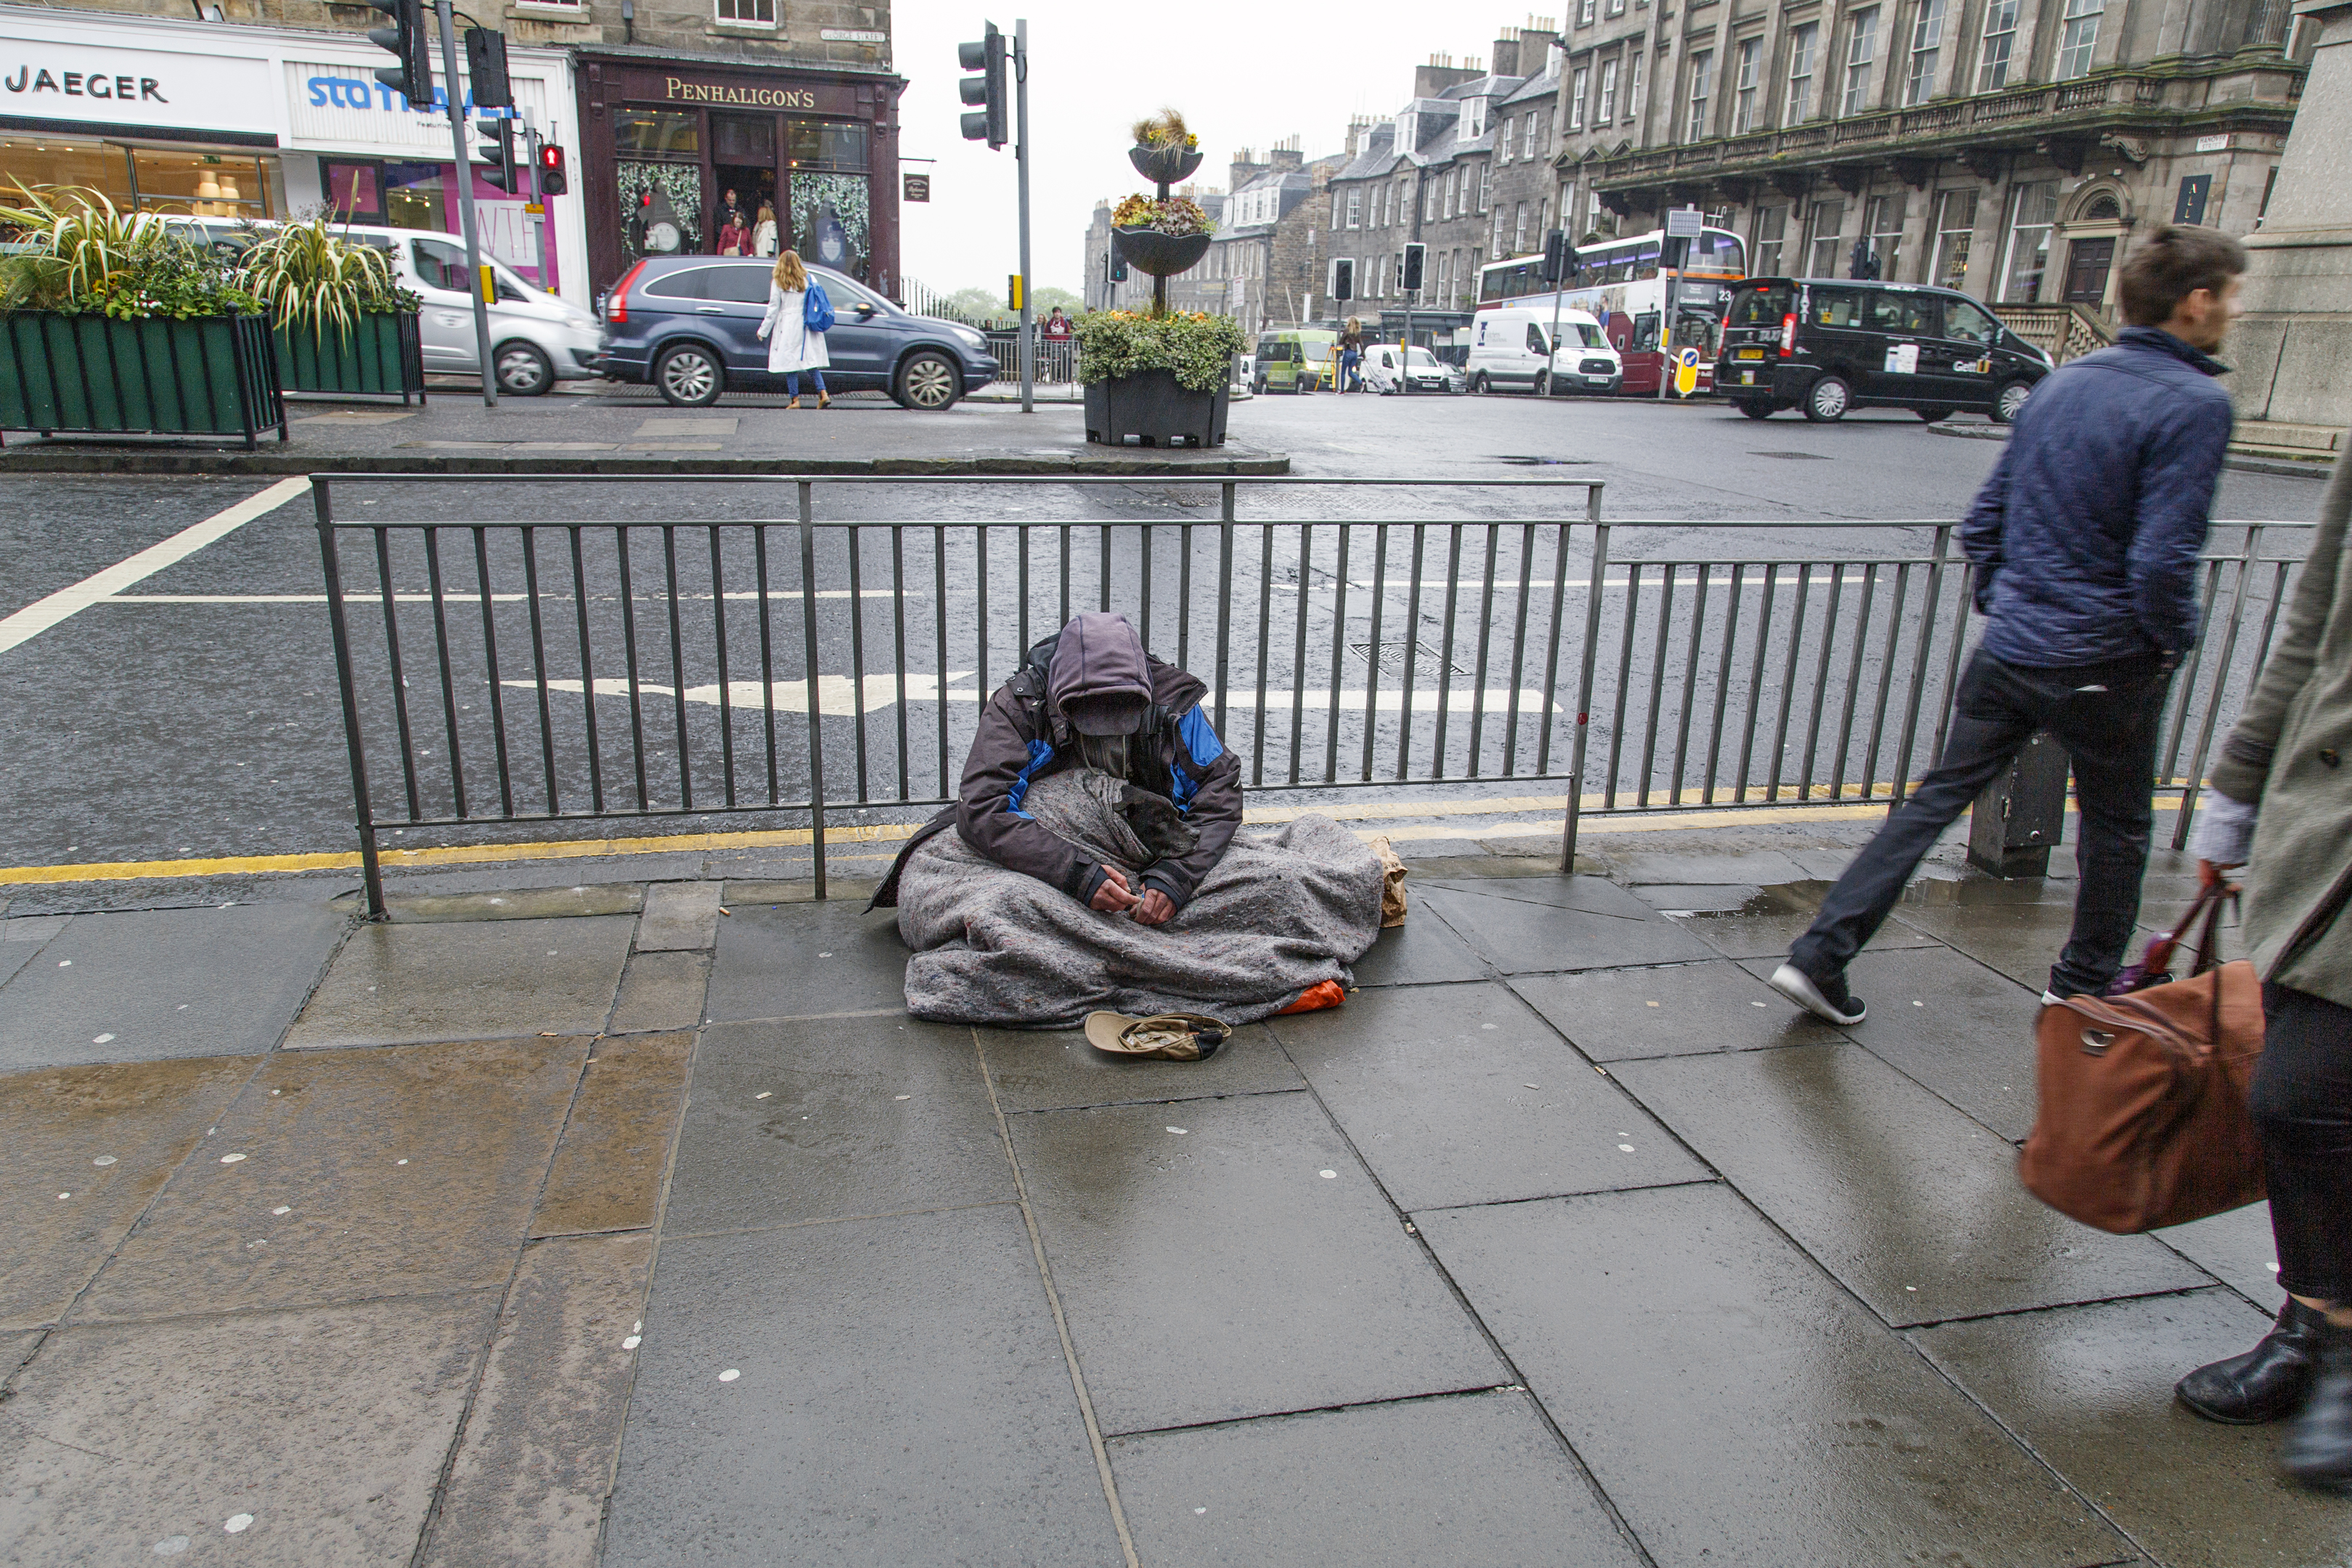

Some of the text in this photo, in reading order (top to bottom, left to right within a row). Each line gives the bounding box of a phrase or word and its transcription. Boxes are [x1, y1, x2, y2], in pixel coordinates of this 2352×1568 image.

[857, 32, 883, 41] STREET
[5, 64, 169, 103] JAEGER
[2200, 134, 2226, 144] HANOVER
[2202, 142, 2222, 150] STREET
[1954, 241, 1969, 253] AL
[1951, 261, 1964, 272] BA
[1946, 280, 1964, 291] ON
[1679, 296, 1710, 305] Greenbank
[1718, 290, 1731, 302] 23
[1800, 285, 1810, 324] TAXI
[1757, 330, 1782, 342] TAXI
